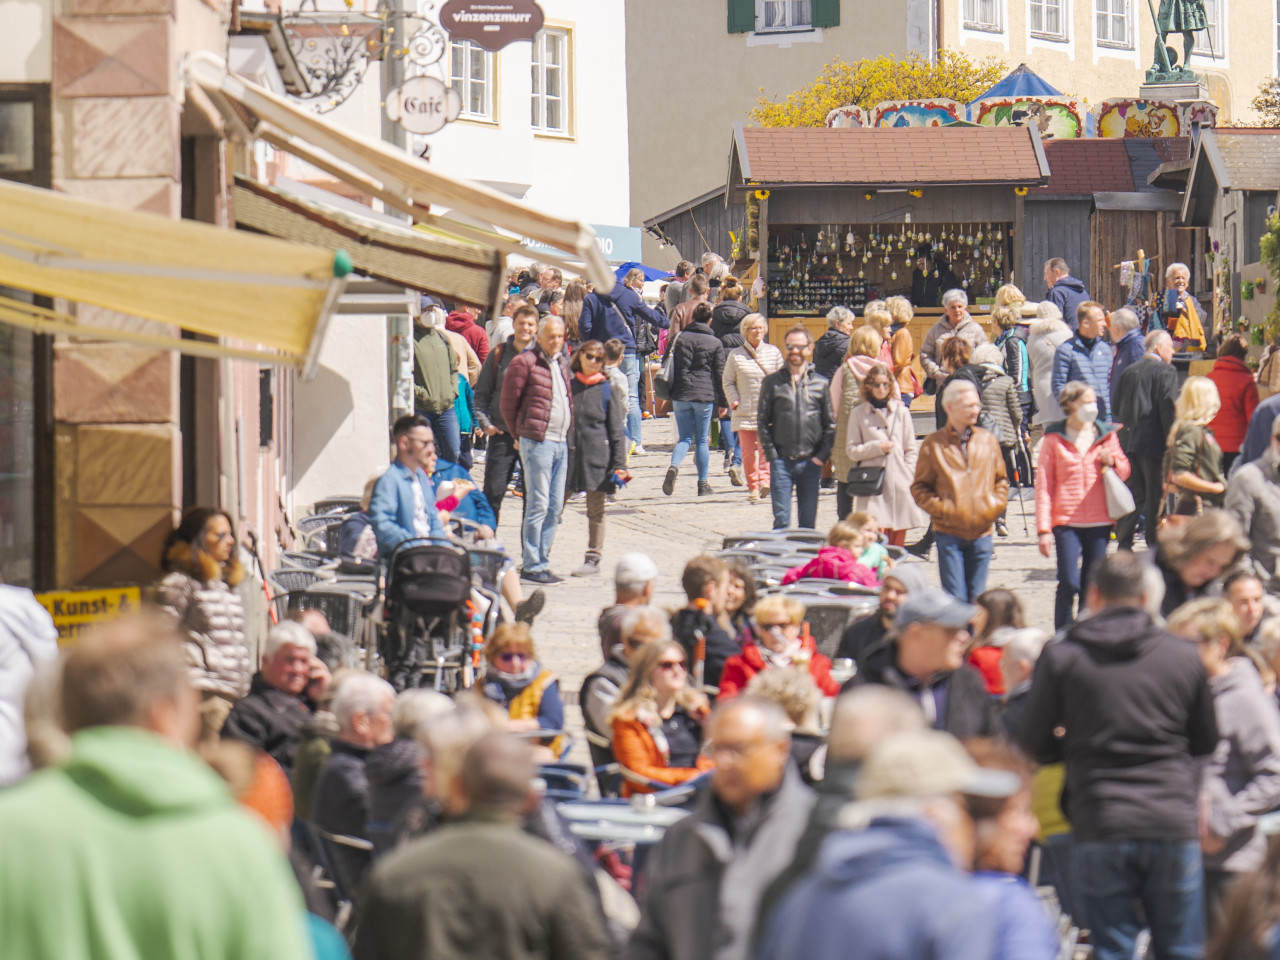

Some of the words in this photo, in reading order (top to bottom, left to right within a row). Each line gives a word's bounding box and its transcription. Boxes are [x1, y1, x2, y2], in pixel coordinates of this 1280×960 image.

[452, 9, 532, 23] vinzenzmurr
[403, 95, 443, 118] Café
[53, 596, 114, 617] Kunst-
